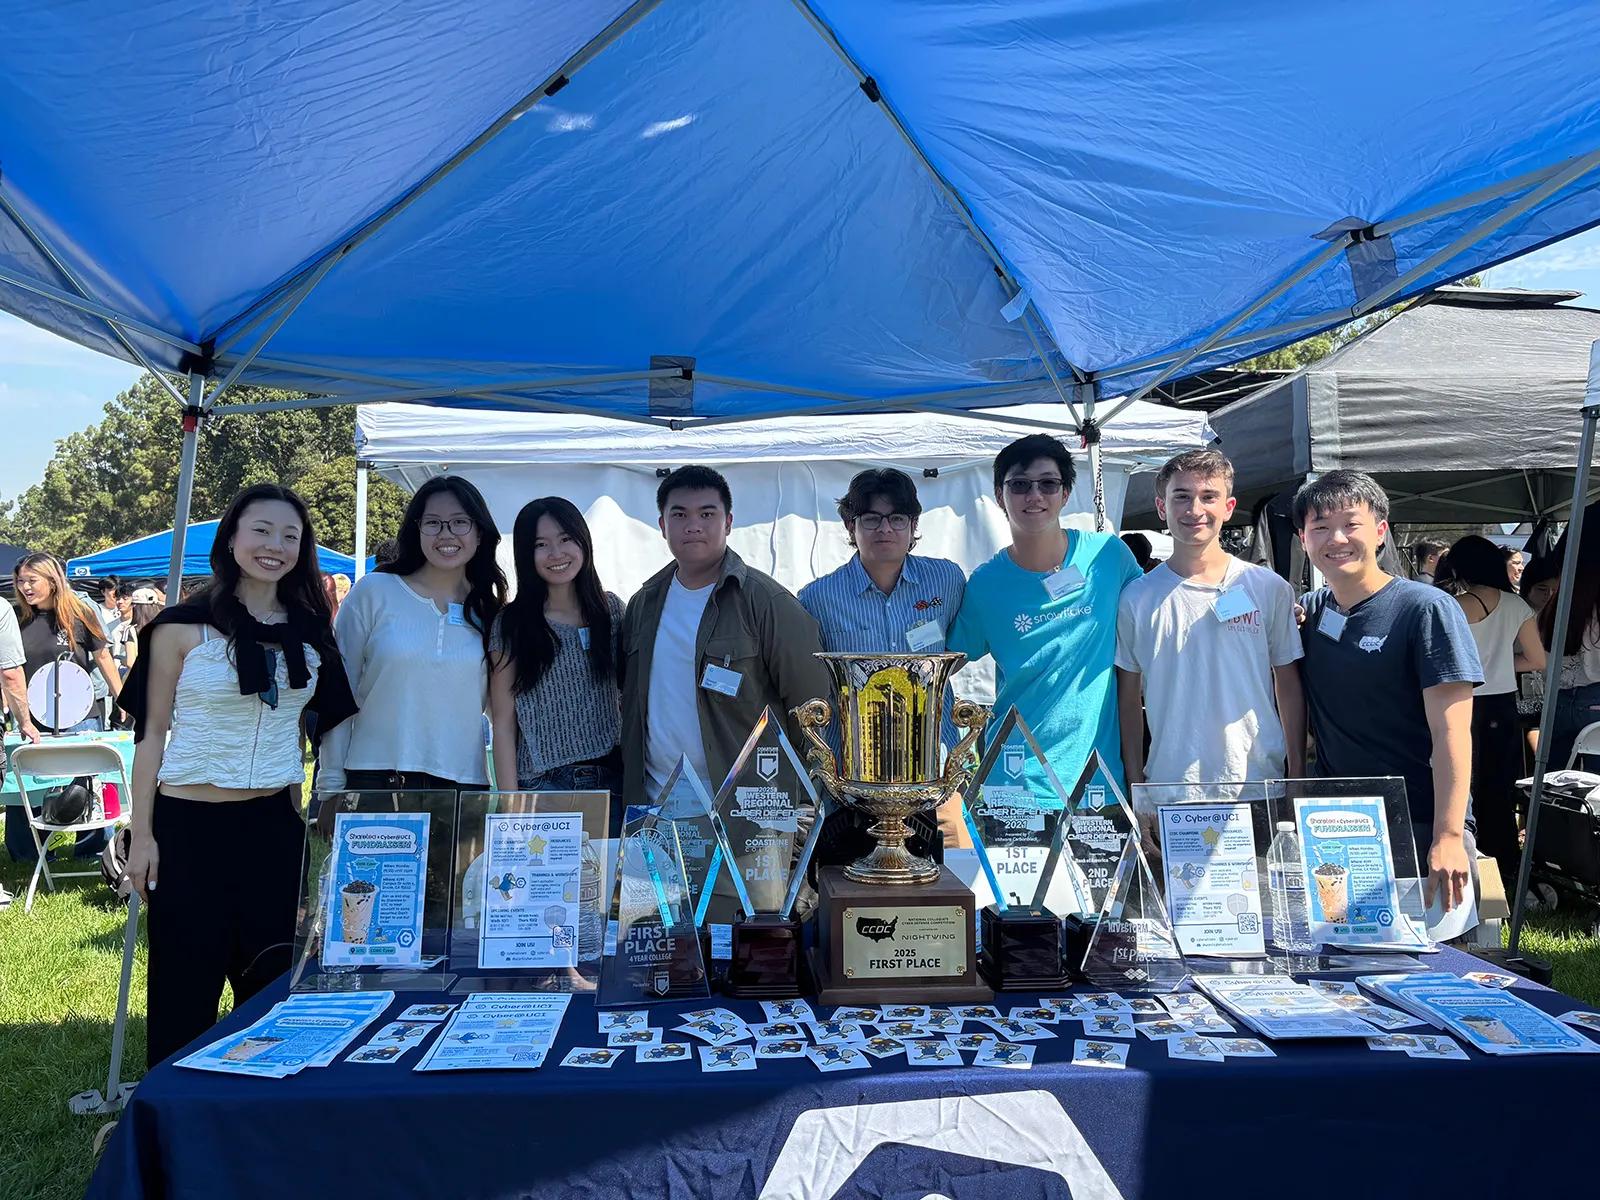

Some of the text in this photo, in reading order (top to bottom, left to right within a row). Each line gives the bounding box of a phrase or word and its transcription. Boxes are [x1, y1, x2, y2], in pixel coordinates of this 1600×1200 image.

[746, 791, 789, 800] WESTERN
[743, 799, 794, 809] REGIONAL
[730, 809, 762, 817] CYBER
[1184, 813, 1240, 824] Cyber@UCI
[513, 822, 571, 832] Cyber@UCI
[1079, 825, 1117, 833] REGIONAL
[1005, 847, 1028, 858] 1ST
[997, 862, 1037, 875] PLACE
[1088, 868, 1108, 877] 2ND
[1083, 879, 1114, 888] PLACE
[628, 925, 670, 940] FIRST
[861, 925, 892, 934] CCDC
[901, 933, 956, 941] NIGHTWING
[624, 938, 676, 954] PLACE
[634, 954, 648, 962] YEAR
[648, 953, 673, 961] COLLEGE
[894, 949, 916, 957] 2025
[1112, 946, 1158, 963] 1st Place
[869, 958, 941, 969] FIRST PLACE
